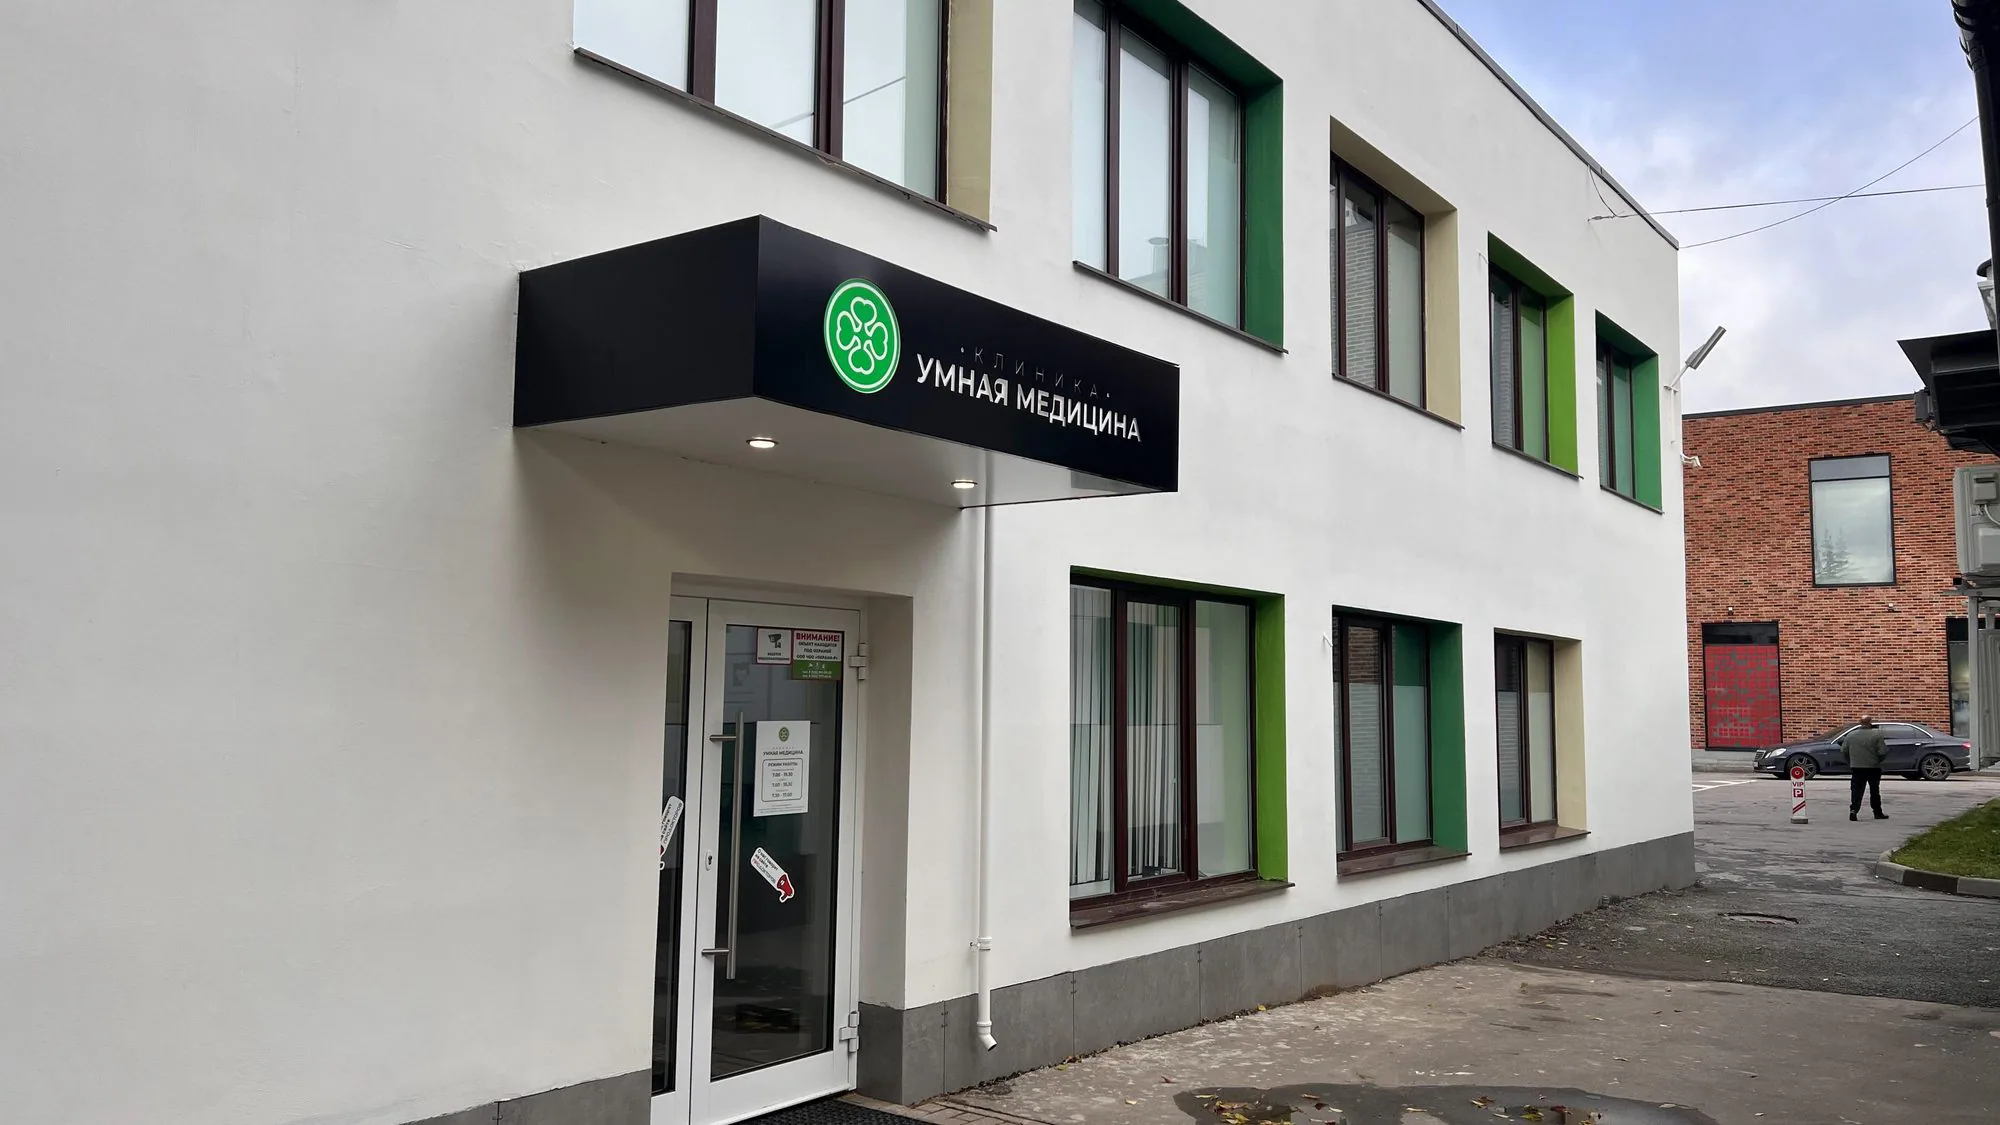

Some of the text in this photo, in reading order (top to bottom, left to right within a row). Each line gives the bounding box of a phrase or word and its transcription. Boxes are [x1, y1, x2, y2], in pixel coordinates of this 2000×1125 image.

[916, 353, 1142, 443] УМНАЯ МЕДИЦИНА
[796, 632, 840, 642] ВНИМАНИЕ!
